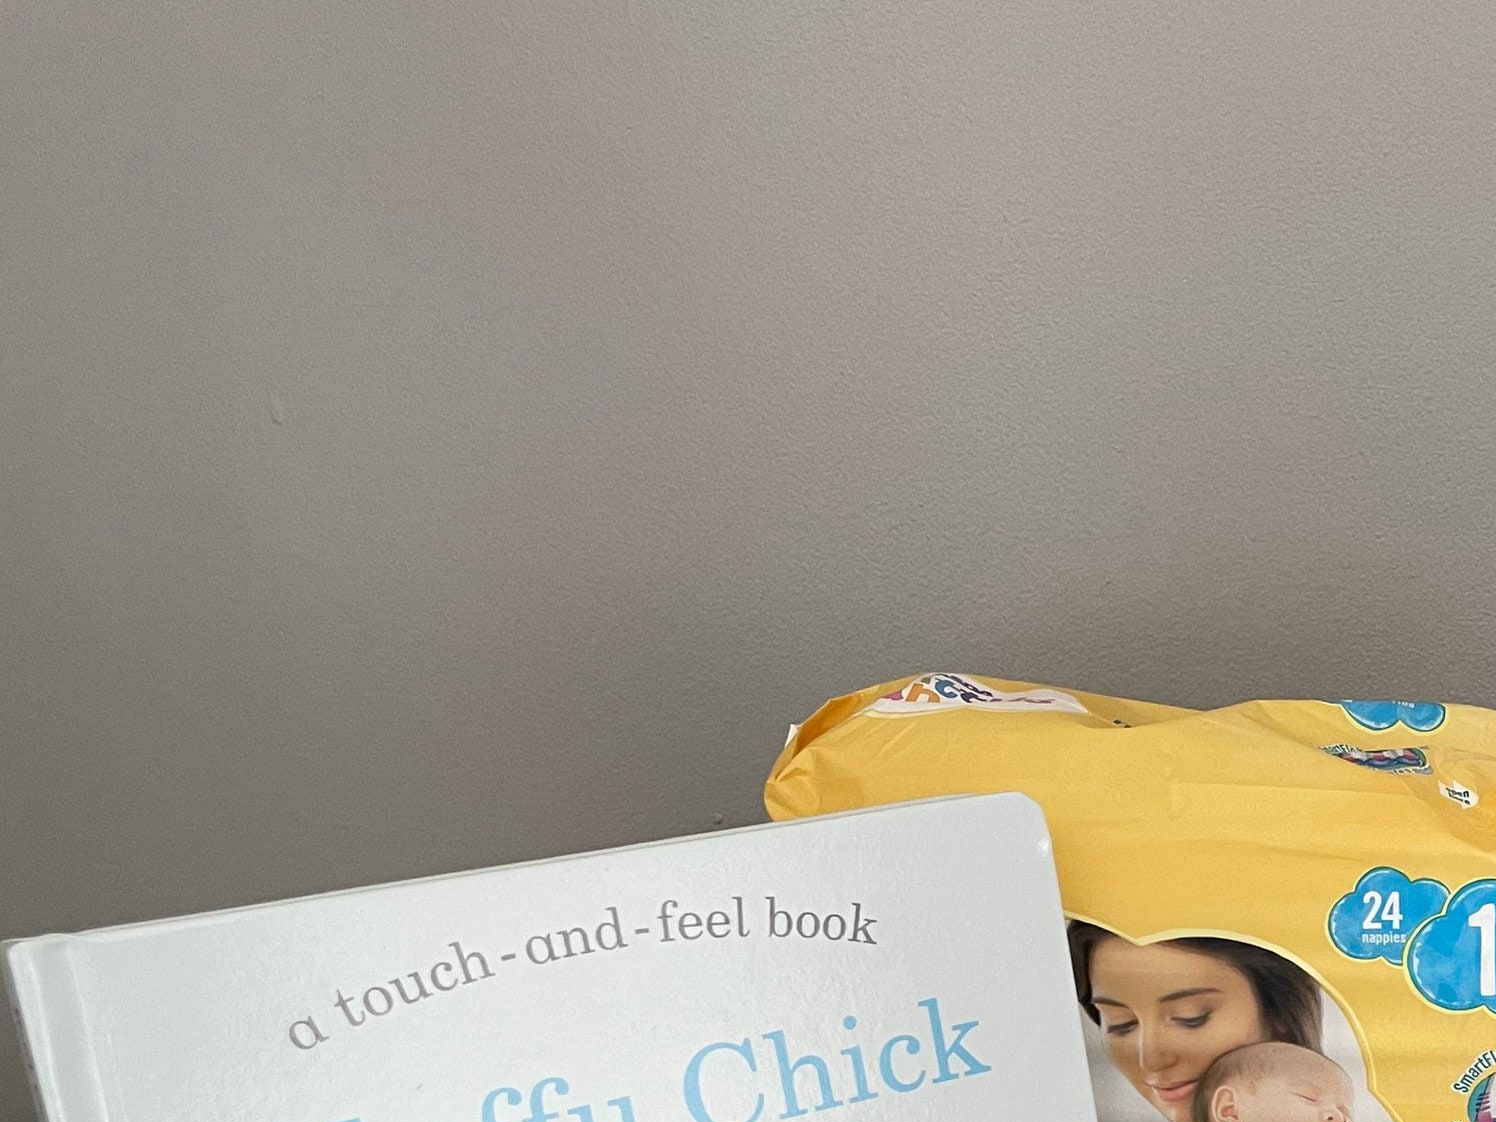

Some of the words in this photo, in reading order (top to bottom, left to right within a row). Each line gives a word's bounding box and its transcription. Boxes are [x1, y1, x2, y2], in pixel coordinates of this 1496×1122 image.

[1362, 932, 1407, 945] nappies
[1363, 891, 1404, 930] 24
[288, 1015, 327, 1050] a
[334, 896, 752, 1029] touch-and-feel
[766, 896, 878, 946] book
[1468, 903, 1496, 996] 1
